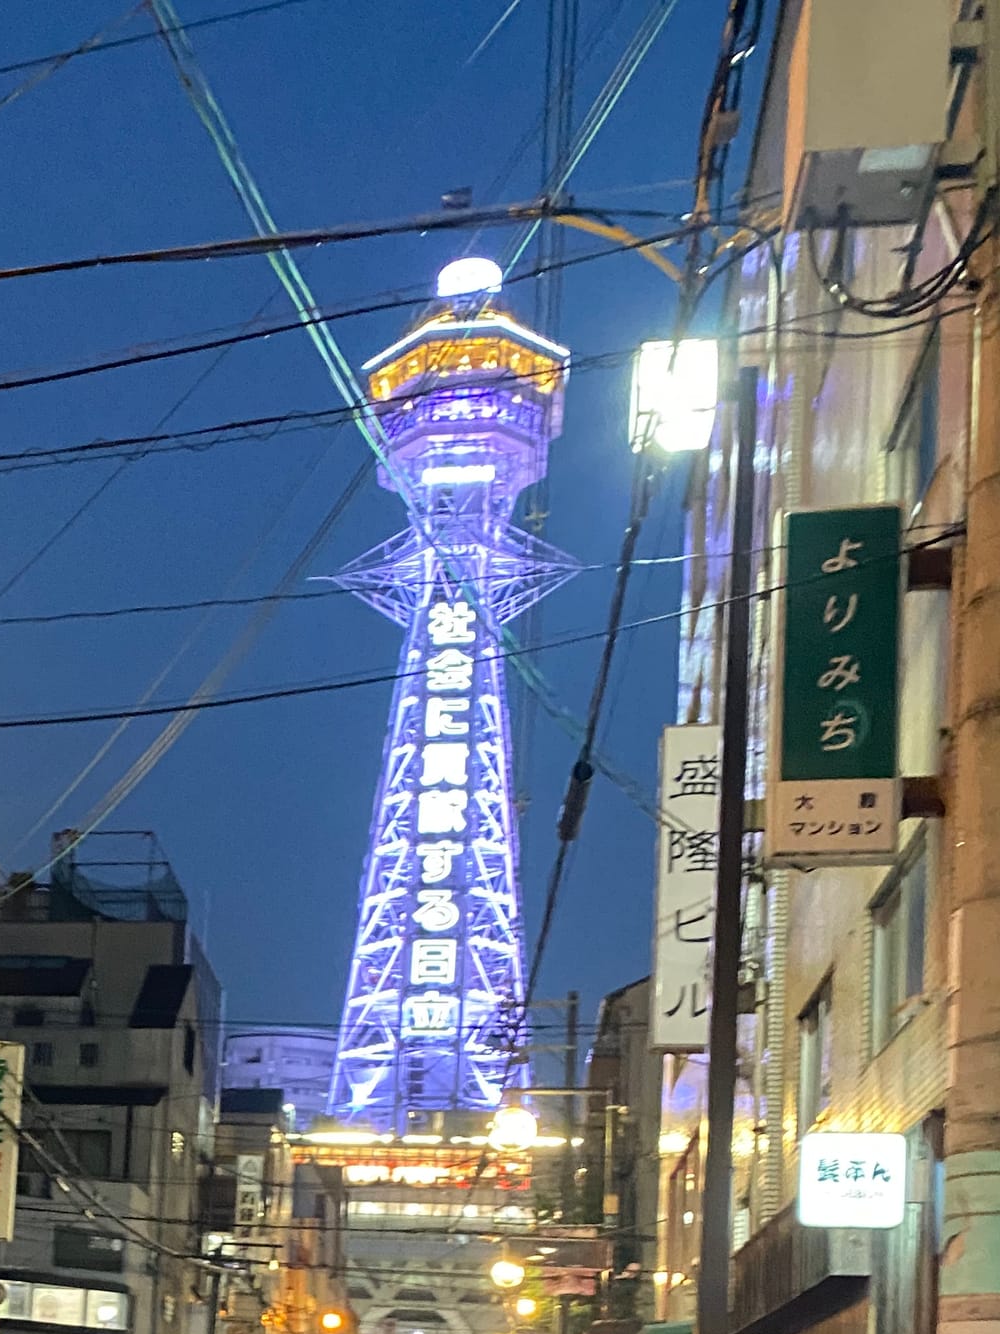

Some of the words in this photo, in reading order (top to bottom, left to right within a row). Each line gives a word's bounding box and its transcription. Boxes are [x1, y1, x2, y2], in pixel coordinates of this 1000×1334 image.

[817, 538, 864, 751] よりみち
[789, 821, 883, 836] マンション
